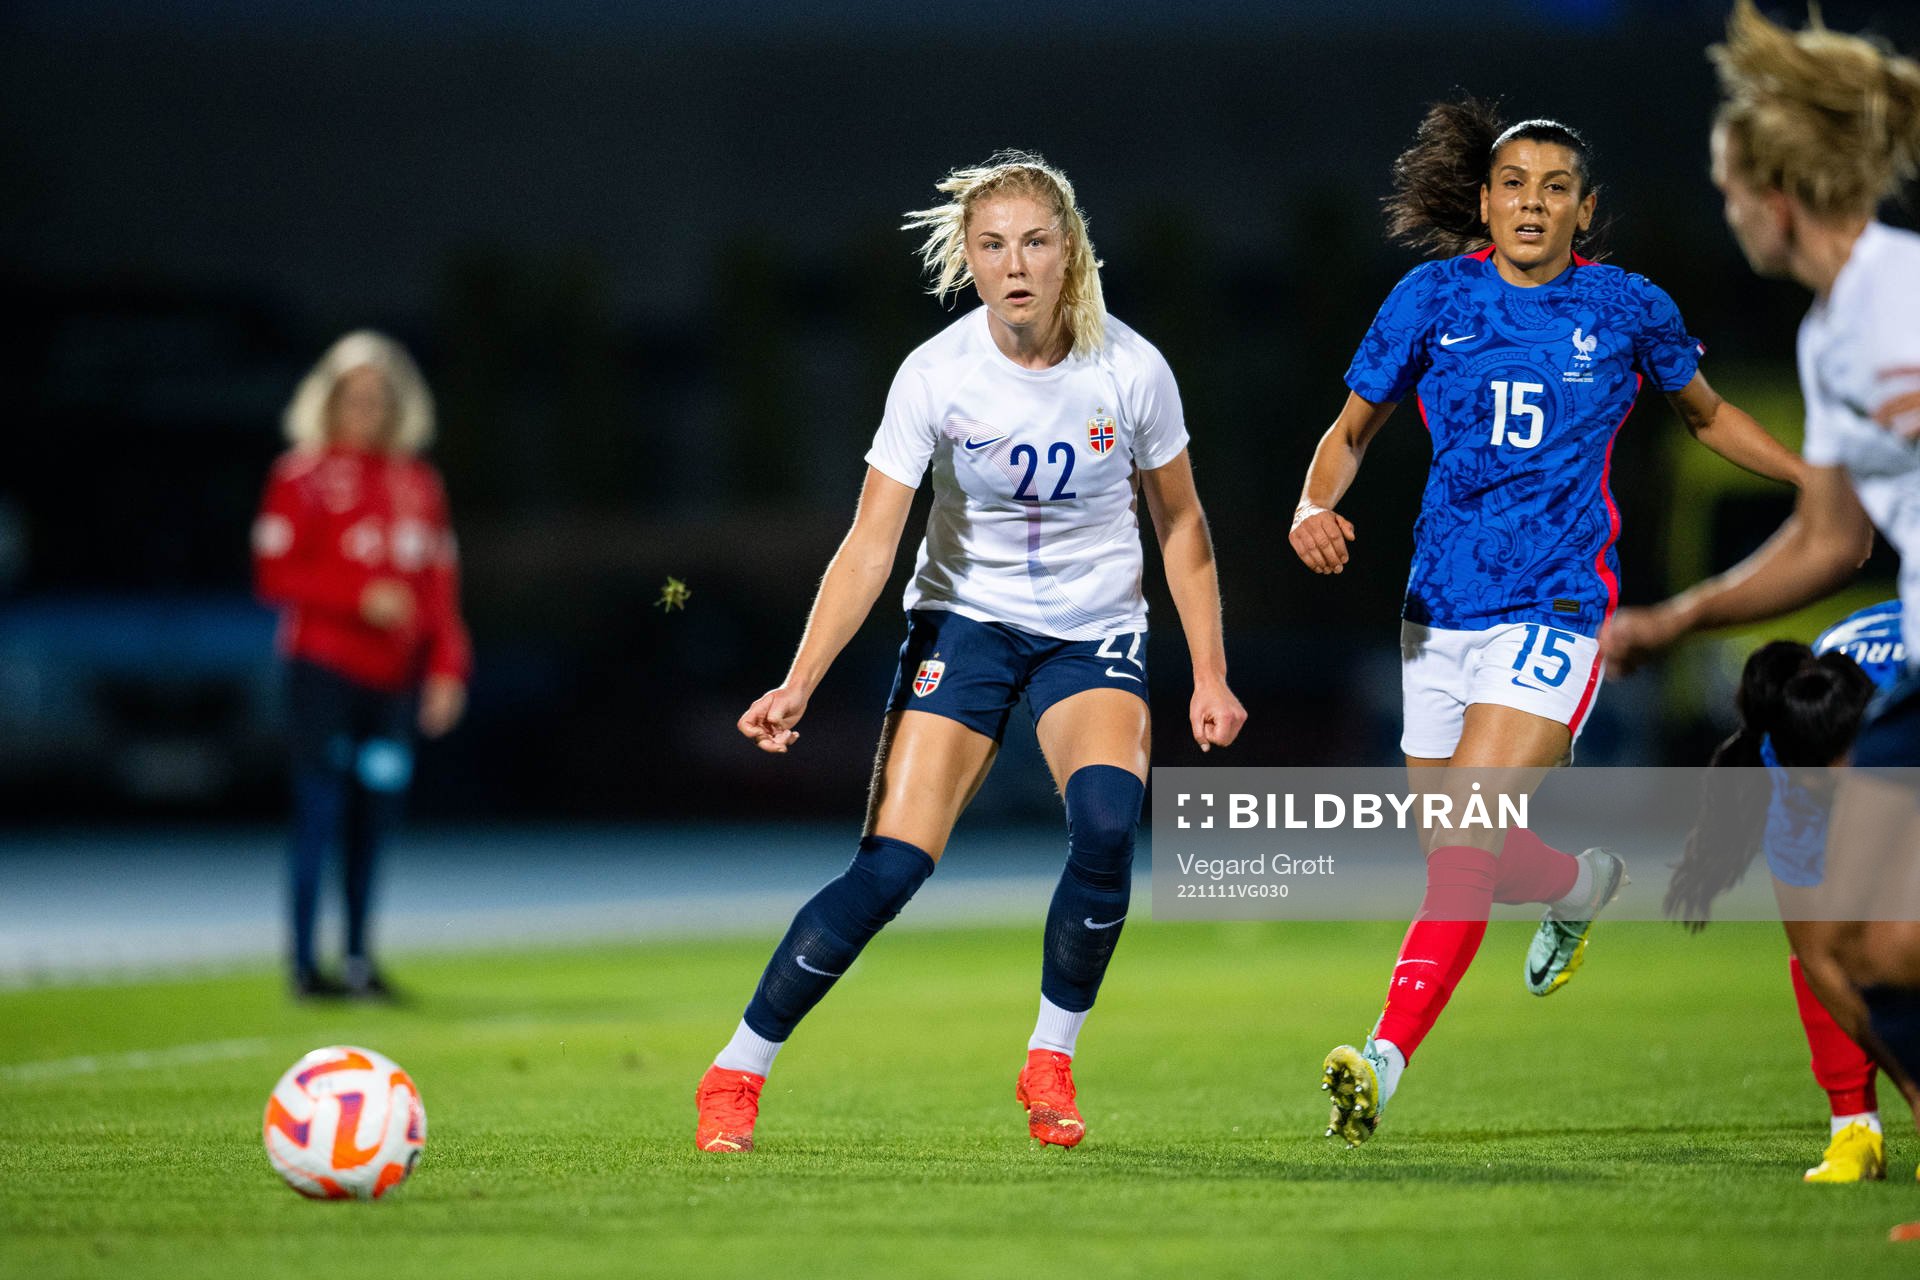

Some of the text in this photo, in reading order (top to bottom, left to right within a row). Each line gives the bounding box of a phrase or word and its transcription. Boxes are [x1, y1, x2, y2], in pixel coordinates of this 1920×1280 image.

[1490, 380, 1544, 449] 15
[1009, 441, 1077, 501] 22
[1512, 624, 1576, 688] 15
